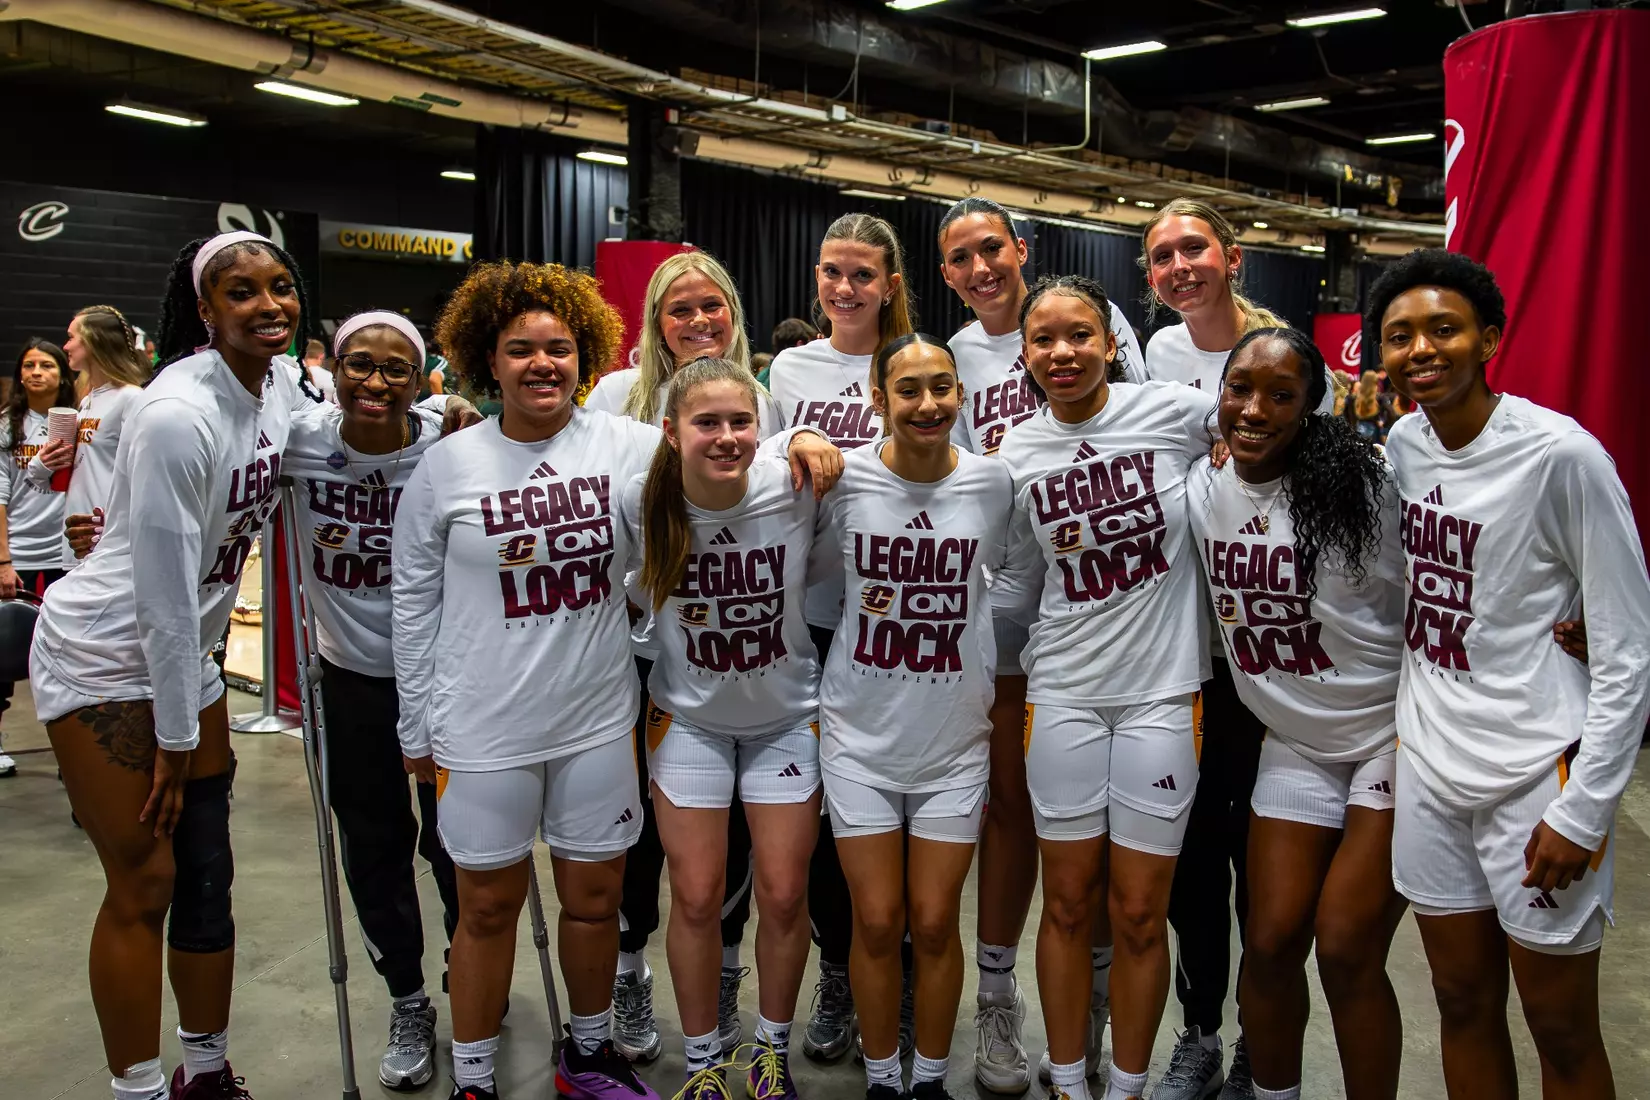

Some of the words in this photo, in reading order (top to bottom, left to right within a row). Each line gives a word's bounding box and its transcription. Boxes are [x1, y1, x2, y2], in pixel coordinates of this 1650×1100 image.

[338, 229, 457, 257] COMMAND
[791, 400, 879, 439] LEGAC
[973, 375, 1037, 430] LEGA
[226, 453, 280, 513] LEGA
[307, 478, 403, 525] LEGA
[480, 475, 610, 536] LEGACY
[1030, 451, 1155, 526] LEGACY
[554, 526, 609, 553] ON
[1098, 503, 1156, 536] ON
[1401, 500, 1483, 572] EGACY
[201, 535, 251, 585] LO
[312, 543, 392, 589] LOC
[668, 545, 786, 599] EGACY
[854, 533, 979, 583] LEGACY
[1056, 527, 1170, 602] LOCK
[498, 552, 615, 619] LOCK
[725, 599, 778, 622] ON
[908, 593, 962, 614] ON
[1252, 599, 1304, 620] ON
[1418, 572, 1464, 604] ON
[505, 600, 611, 630] CHIPPEWS
[1405, 596, 1476, 672] OCK
[679, 617, 788, 673] LOCK
[853, 613, 967, 673] LOCK
